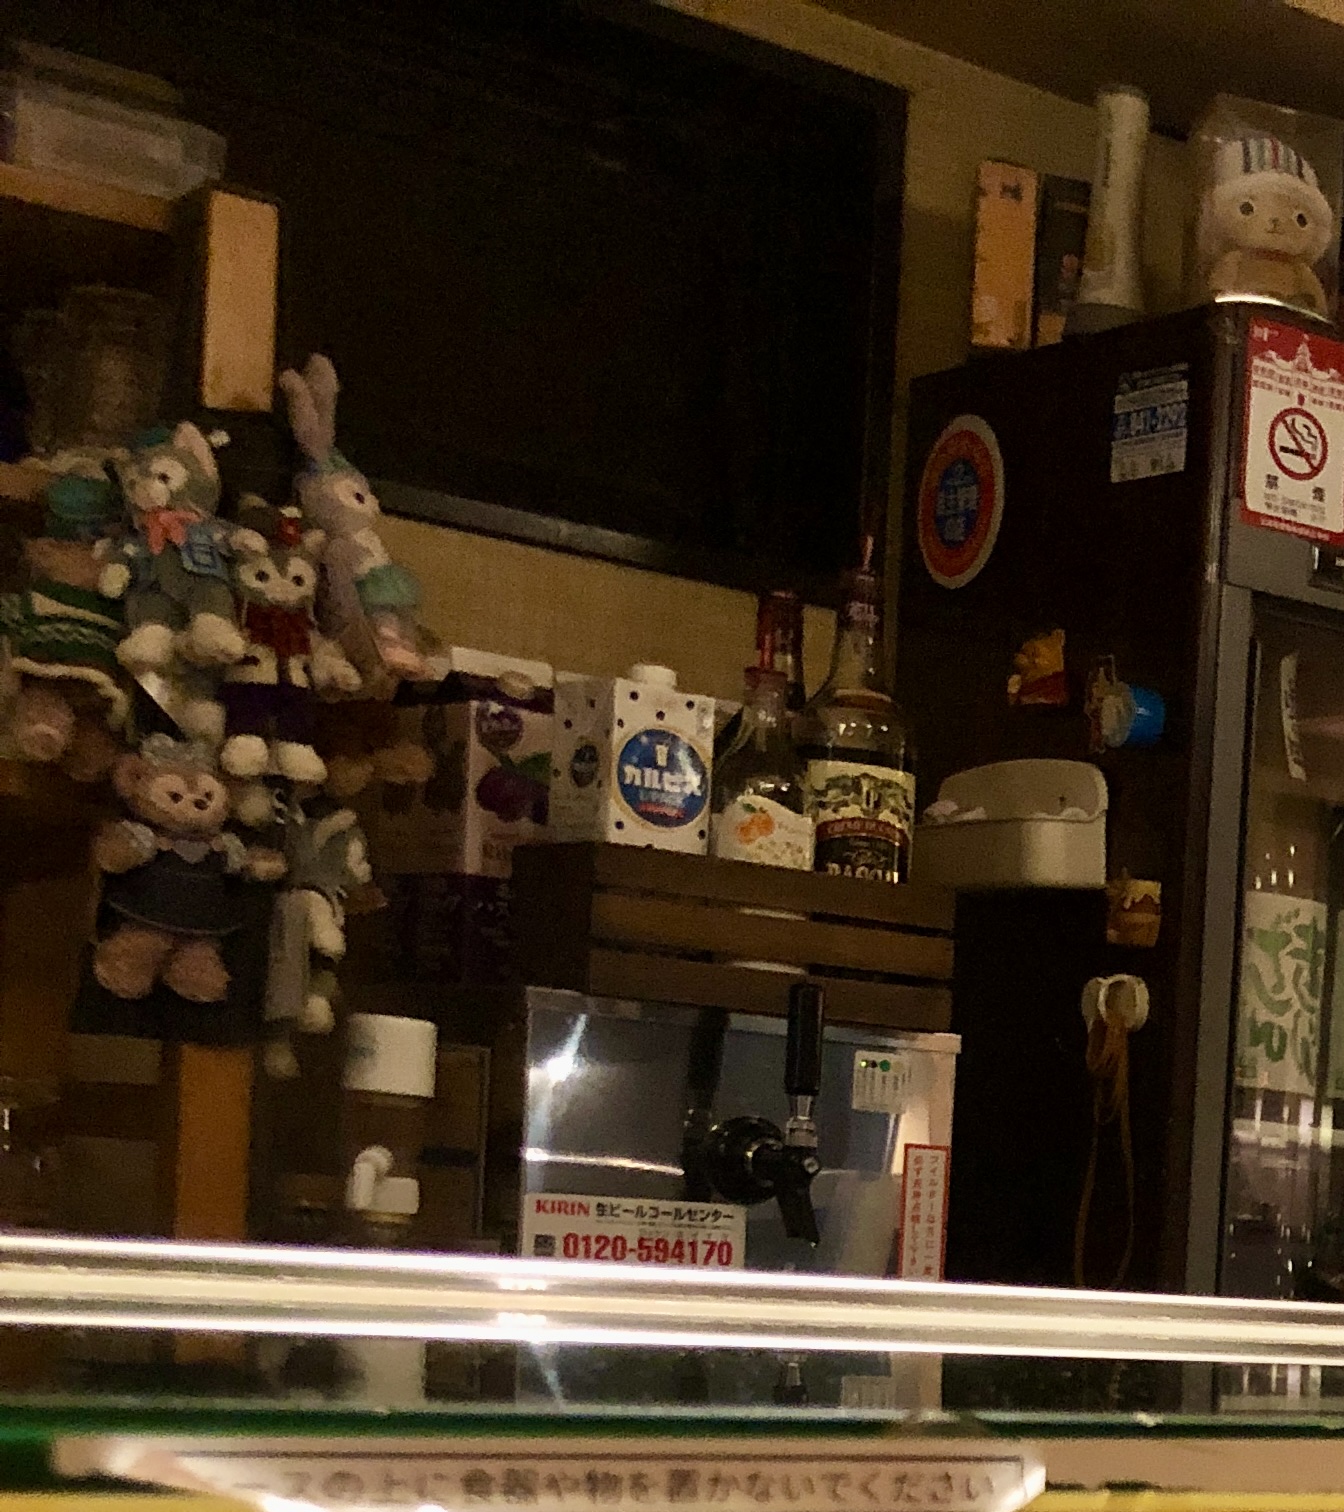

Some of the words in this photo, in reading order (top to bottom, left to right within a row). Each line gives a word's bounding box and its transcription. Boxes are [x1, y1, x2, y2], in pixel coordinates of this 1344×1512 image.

[534, 1198, 590, 1217] KIRIN
[595, 1201, 735, 1222] 生ビールコールセンター
[562, 1232, 733, 1267] 0120-594170
[234, 1463, 996, 1506] ースの上に食器や物を置かないでください
